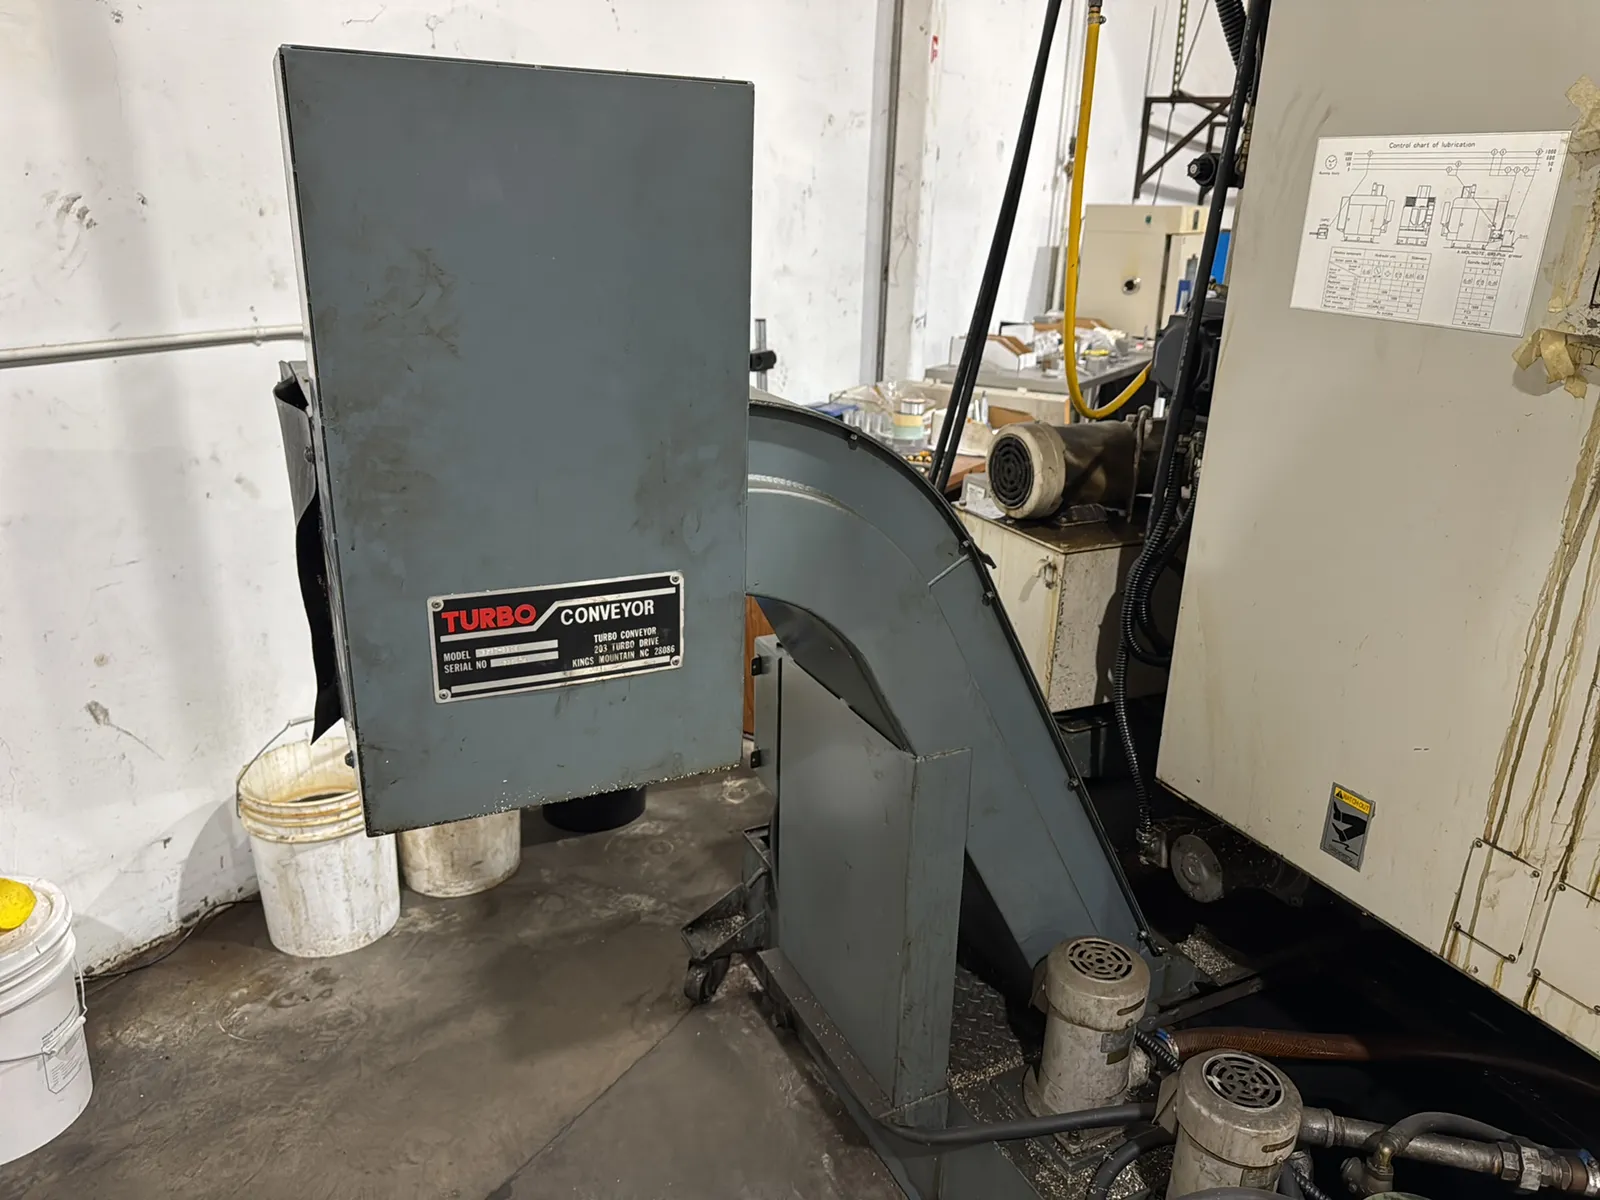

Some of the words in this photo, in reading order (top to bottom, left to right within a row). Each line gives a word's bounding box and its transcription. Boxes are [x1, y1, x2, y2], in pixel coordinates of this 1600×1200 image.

[441, 603, 537, 633] TURBO
[560, 599, 655, 626] CONVEYOR
[593, 633, 617, 643] TURBO
[620, 626, 657, 640] CONVEYOR
[594, 644, 608, 654] 203
[612, 641, 635, 652] TURBO
[639, 637, 660, 648] DRIVE
[443, 650, 471, 662] MODEL
[572, 656, 594, 668] KINGS
[598, 650, 635, 664] MOUNTAIN
[639, 648, 650, 658] NC
[654, 645, 676, 656] 28086
[443, 662, 473, 674] SERIAL
[475, 660, 487, 670] NO
